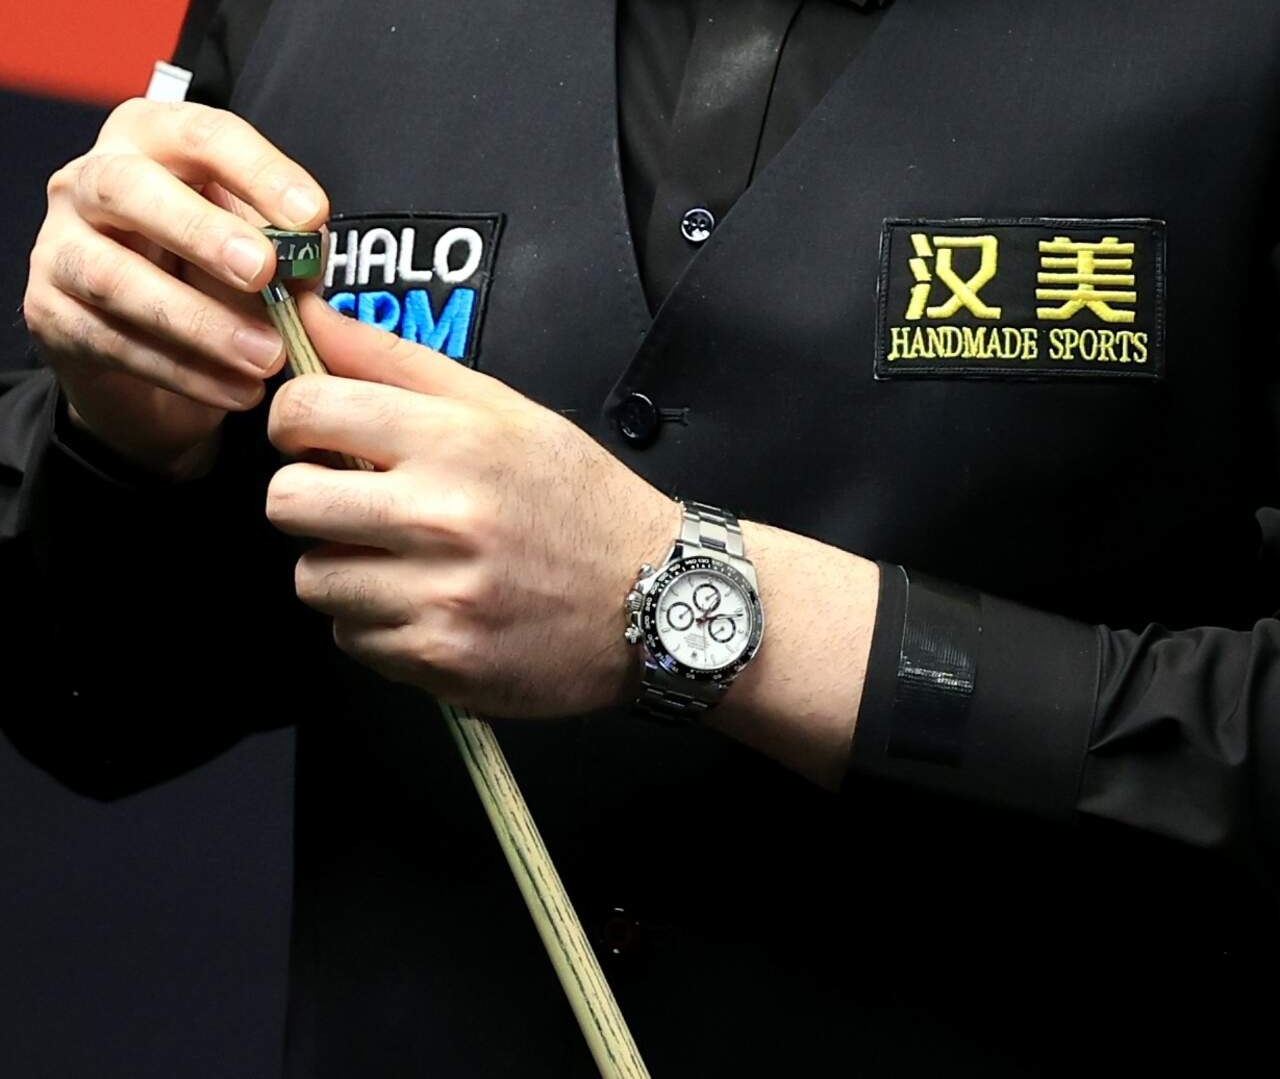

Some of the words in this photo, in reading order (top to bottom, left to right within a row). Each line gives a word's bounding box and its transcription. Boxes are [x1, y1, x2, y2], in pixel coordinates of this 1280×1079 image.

[324, 227, 483, 288] HALO
[905, 233, 1137, 323] 汉美
[887, 325, 1039, 361] HANDMADE
[1048, 327, 1149, 363] SPORTS
